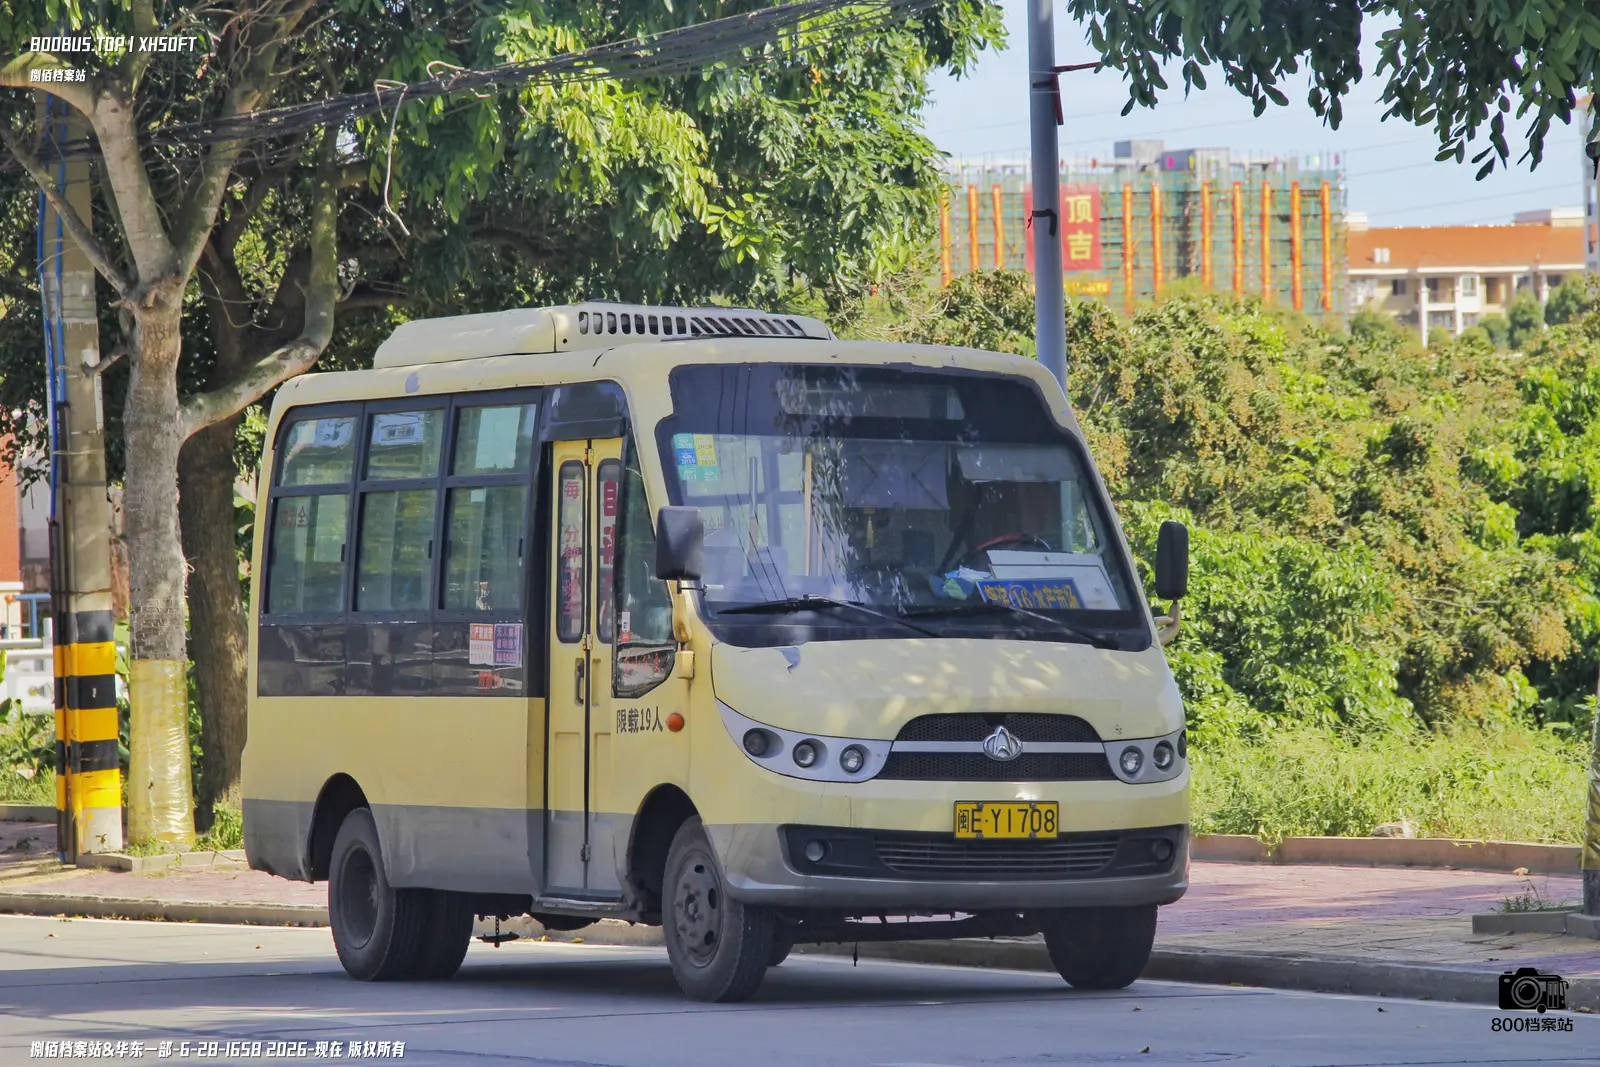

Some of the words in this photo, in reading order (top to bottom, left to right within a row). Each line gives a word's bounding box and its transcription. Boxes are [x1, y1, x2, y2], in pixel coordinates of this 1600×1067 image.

[1065, 195, 1094, 260] 顶吉
[616, 705, 664, 734] 限载19人
